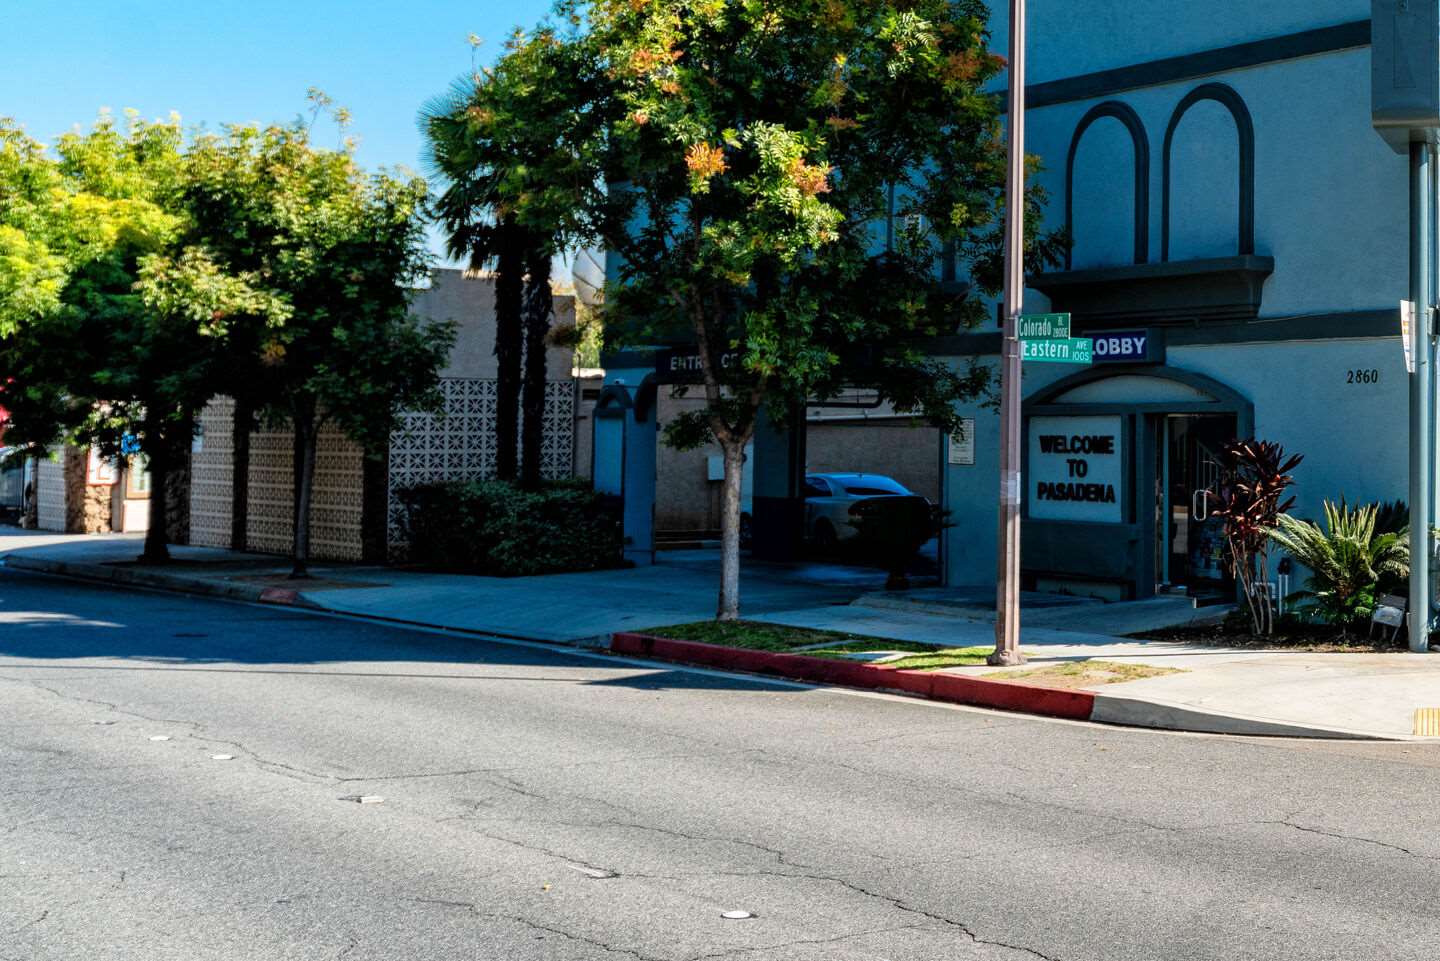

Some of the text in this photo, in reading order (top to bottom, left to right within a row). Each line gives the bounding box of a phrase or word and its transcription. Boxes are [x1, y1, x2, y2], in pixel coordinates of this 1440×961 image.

[1019, 318, 1052, 337] Colorado
[1022, 341, 1088, 358] Eastern AVE
[1093, 337, 1146, 356] OBBY
[1347, 369, 1378, 384] 2860
[1039, 435, 1114, 454] WELCOME
[1066, 459, 1088, 478] TO
[1038, 482, 1115, 503] PASADENA
